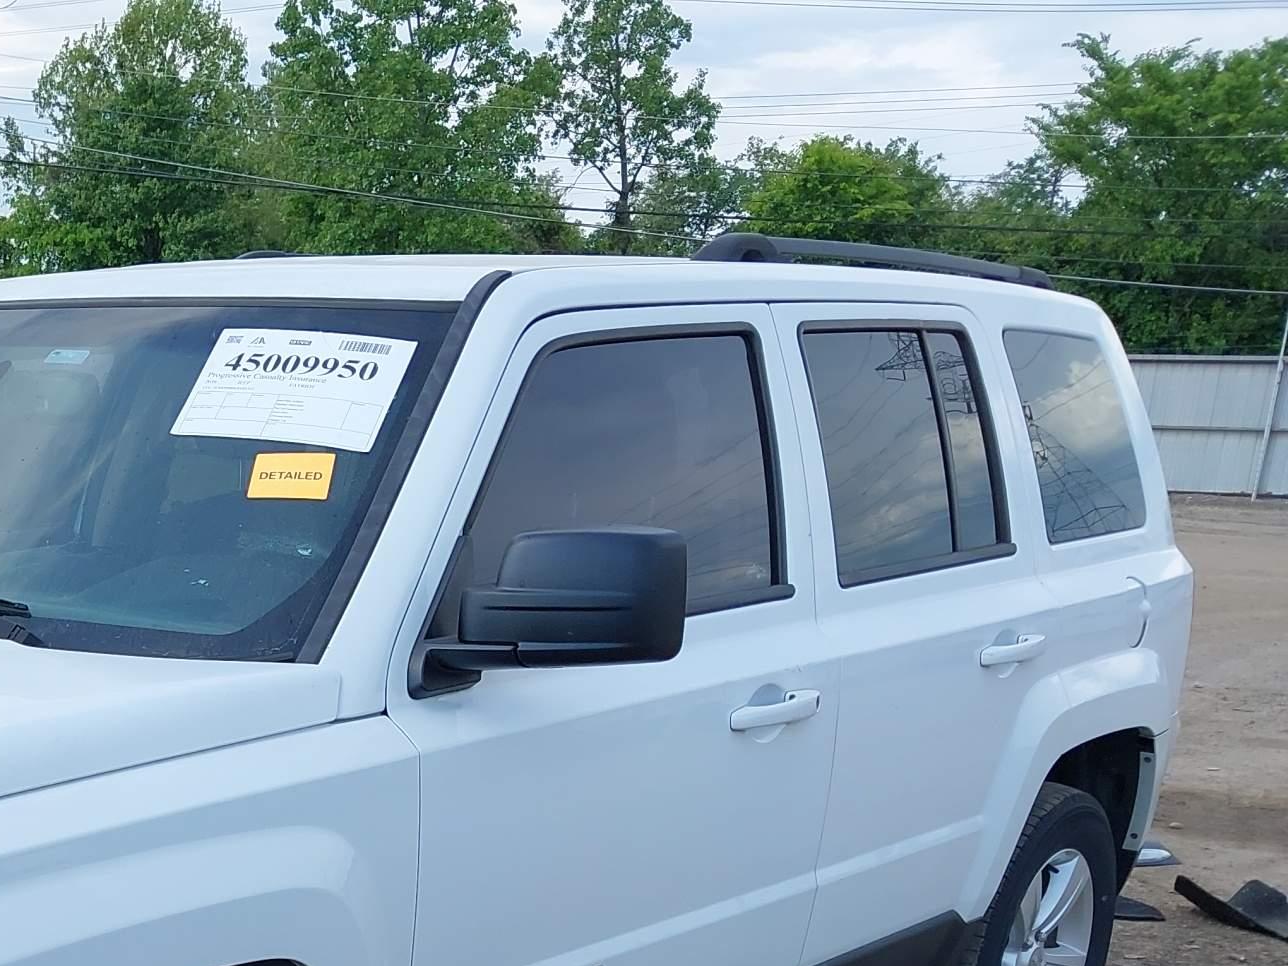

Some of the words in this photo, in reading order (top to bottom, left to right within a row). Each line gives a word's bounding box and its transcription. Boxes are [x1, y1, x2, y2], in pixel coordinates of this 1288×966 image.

[224, 352, 379, 382] 45009950
[208, 371, 252, 380] Progressive
[253, 373, 286, 381] Casualty
[288, 374, 327, 384] Insurance
[259, 471, 323, 481] DETAILED
